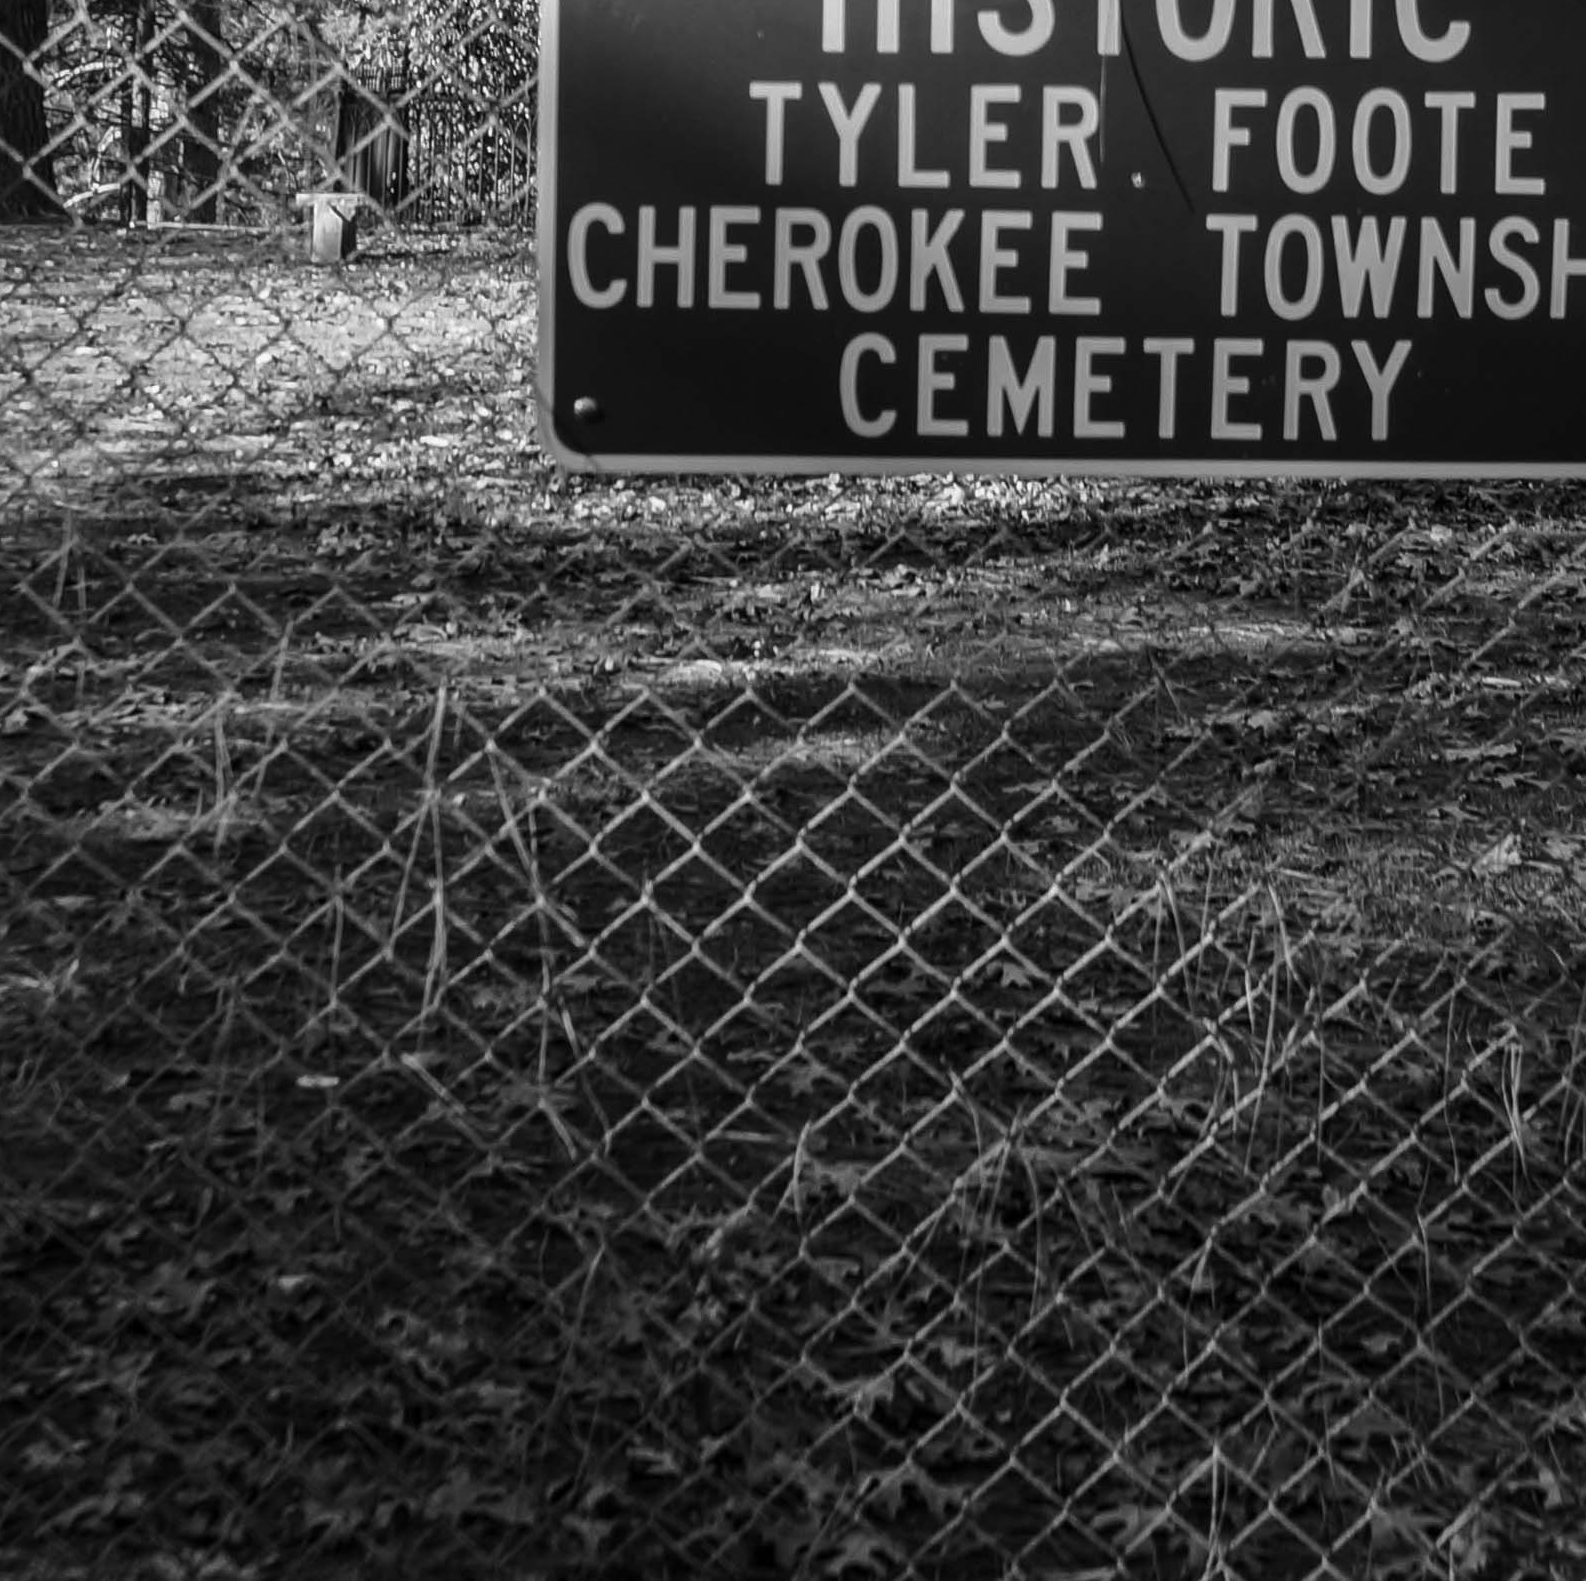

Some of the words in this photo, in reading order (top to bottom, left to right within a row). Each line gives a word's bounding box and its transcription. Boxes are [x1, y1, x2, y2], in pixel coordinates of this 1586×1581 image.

[748, 80, 1102, 191] TYLER
[1213, 87, 1548, 196] FOOTE
[567, 203, 1104, 315] CHEROKEE
[837, 332, 1414, 441] CEMETERY
